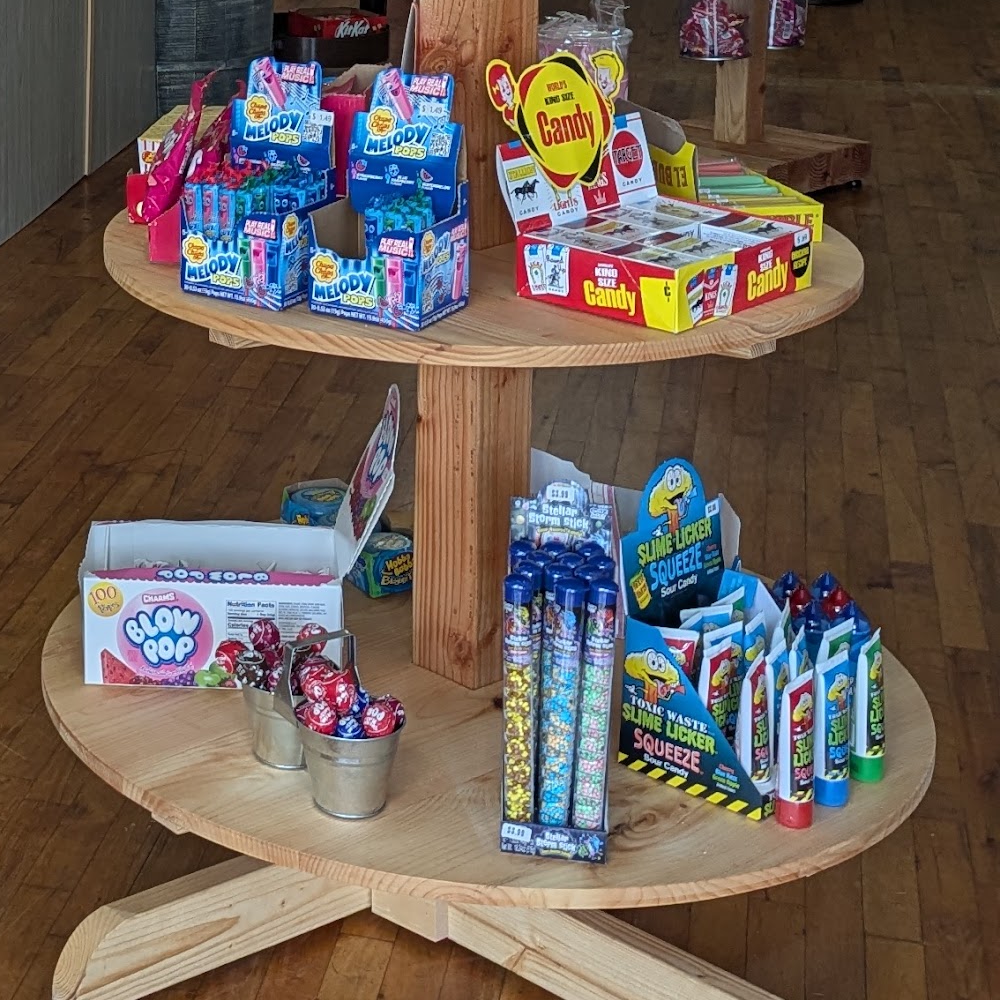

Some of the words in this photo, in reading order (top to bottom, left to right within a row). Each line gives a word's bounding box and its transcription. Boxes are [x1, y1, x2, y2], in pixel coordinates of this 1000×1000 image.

[546, 80, 567, 92] WORLD'S
[561, 92, 575, 101] SIZE
[245, 111, 302, 140] MELODY
[536, 104, 595, 148] Candy
[271, 132, 300, 144] POPS
[366, 124, 431, 153] MELODY
[394, 146, 425, 158] POPS
[622, 177, 642, 187] CANDY
[519, 206, 540, 215] CANDY
[557, 207, 579, 217] CANDY
[186, 253, 241, 280] MELODY
[594, 266, 618, 277] KING
[212, 274, 241, 287] POPS
[313, 272, 375, 300] MELODY
[597, 277, 617, 288] SIZE
[747, 257, 789, 301] Candy
[343, 295, 374, 308] POPS
[583, 280, 636, 316] Candy
[528, 513, 560, 526] Storm
[564, 516, 589, 530] Stick
[542, 504, 578, 518] Stellar
[637, 532, 674, 567] SLIME
[675, 516, 712, 551] LICKER
[157, 569, 205, 581] POP
[650, 541, 703, 591] SQUEEZE
[89, 586, 117, 605] 100
[661, 583, 677, 598] Sour
[678, 574, 698, 590] Candy
[143, 592, 175, 603] CHARMS
[125, 607, 200, 645] BLOW
[142, 636, 195, 664] POP
[629, 694, 665, 717] TOXIC
[666, 709, 708, 734] WASTE
[622, 702, 663, 734] SLIME
[666, 720, 717, 755] LICKER
[633, 727, 701, 774] SQUEEZE
[643, 753, 663, 767] Sour
[663, 761, 690, 778] Candy
